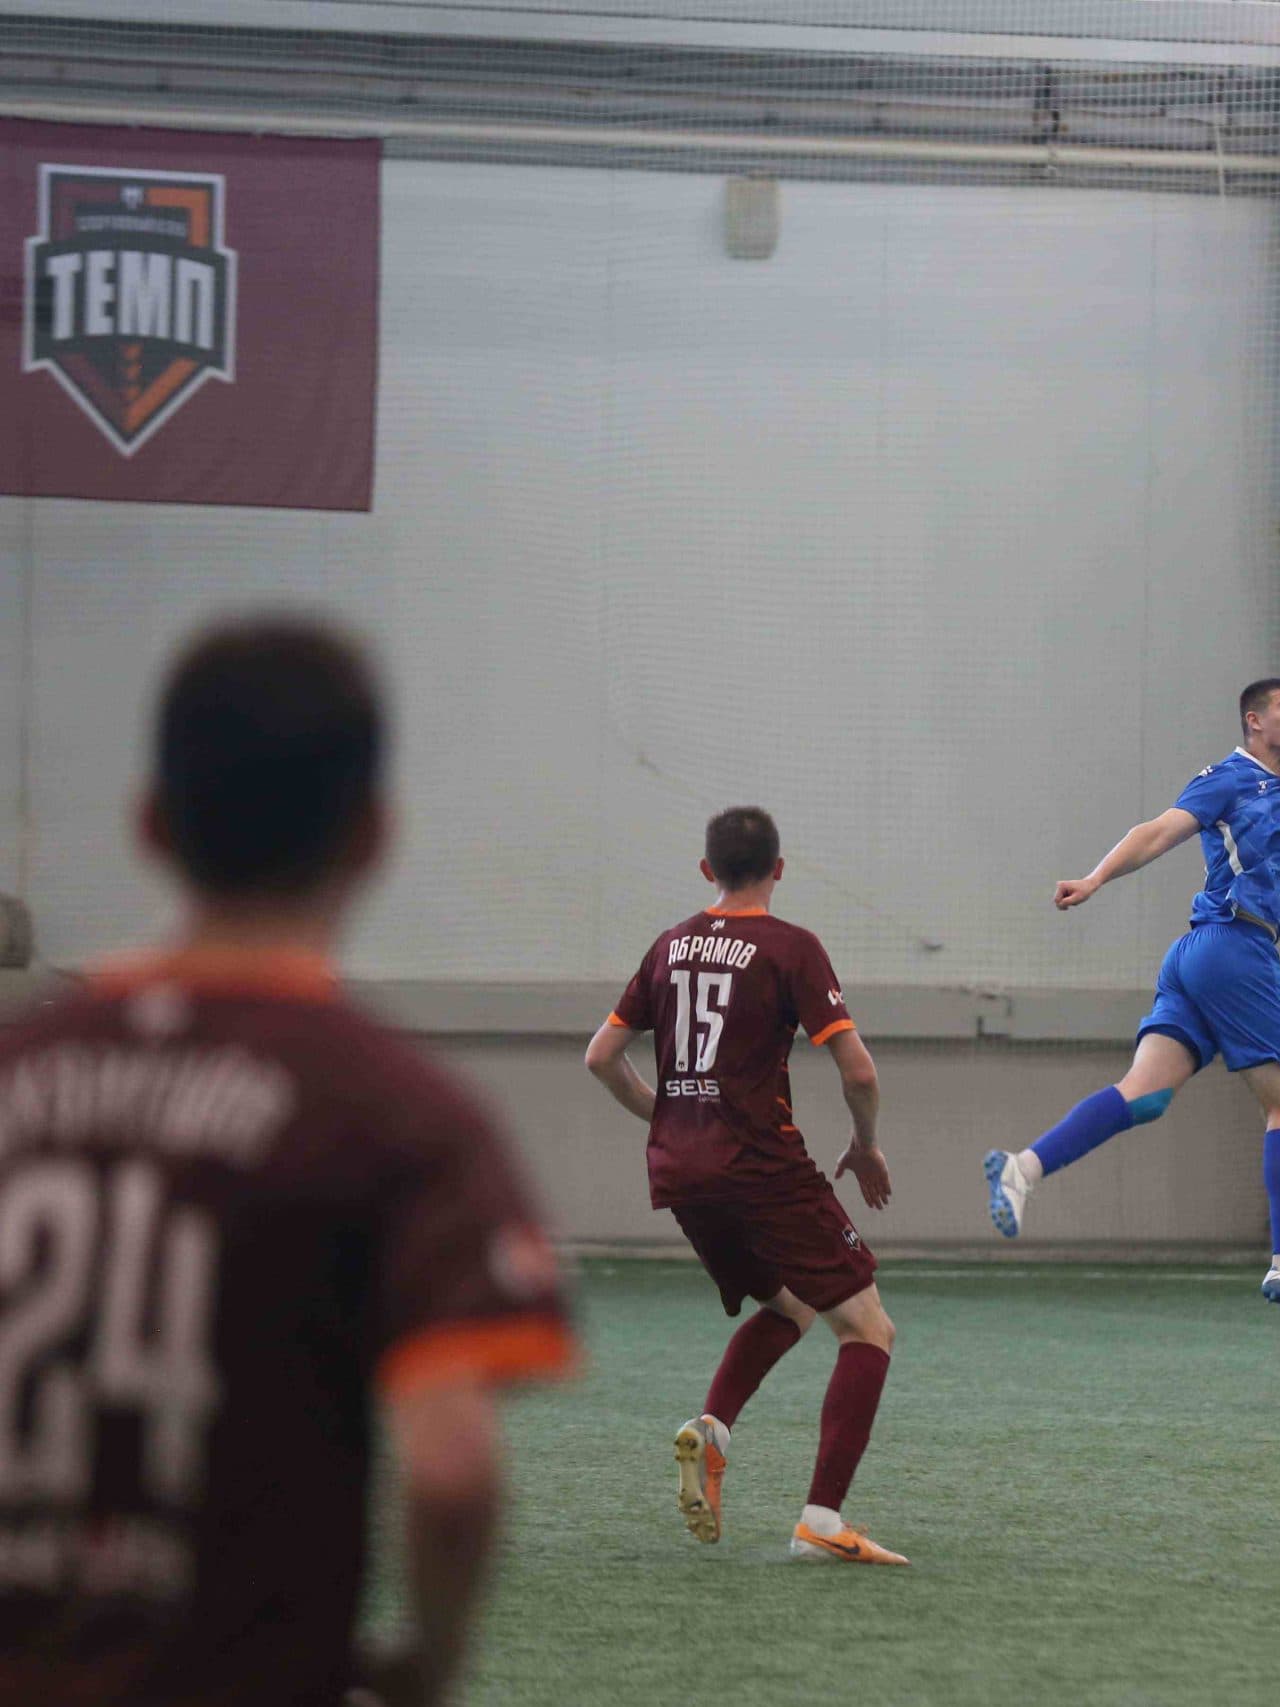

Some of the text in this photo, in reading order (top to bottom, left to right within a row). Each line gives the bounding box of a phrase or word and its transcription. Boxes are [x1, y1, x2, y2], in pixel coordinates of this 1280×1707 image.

[46, 249, 215, 350] ТЕМП
[668, 935, 757, 970] АБРАМОВ
[670, 969, 733, 1072] 15
[0, 1156, 222, 1502] 24
